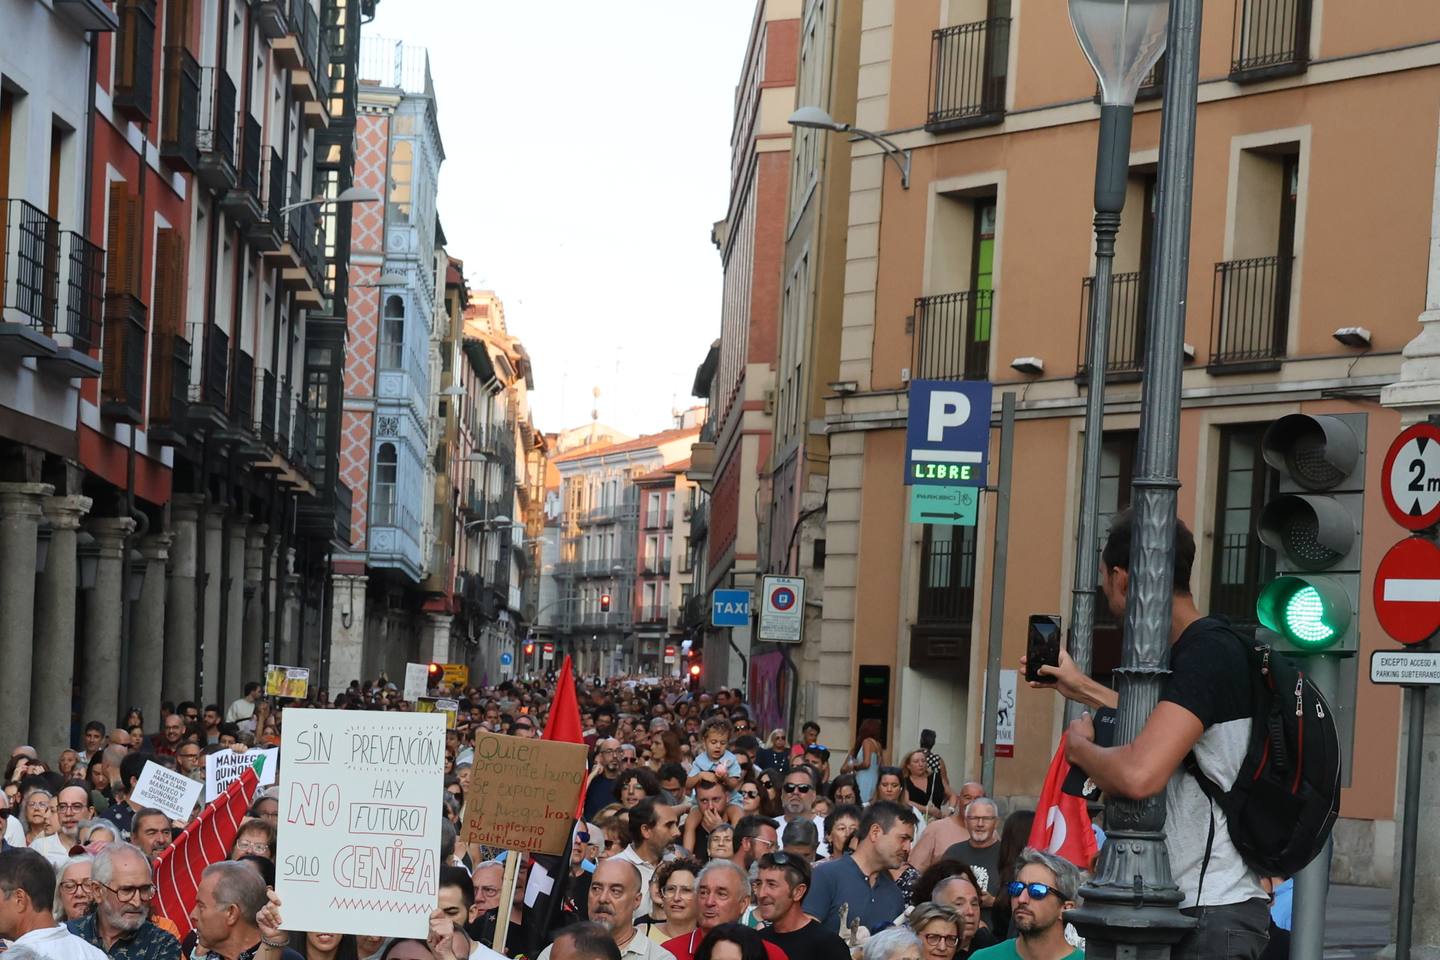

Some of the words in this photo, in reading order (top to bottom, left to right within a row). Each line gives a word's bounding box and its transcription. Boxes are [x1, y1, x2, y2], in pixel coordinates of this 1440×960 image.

[927, 391, 971, 442] P
[915, 464, 971, 479] LIBRE
[715, 602, 748, 615] TAXI
[1380, 658, 1409, 667] EXCEPTO
[1410, 659, 1432, 667] ACCESO
[1376, 670, 1400, 678] PARKING
[295, 724, 333, 762] SIN
[351, 731, 441, 766] PREVENCIÓN
[216, 754, 258, 768] MAÑUEC
[153, 774, 169, 784] HABLA
[169, 780, 186, 792] CLARO
[163, 771, 188, 787] ESTATUTO
[141, 790, 184, 813] RESPONSABLES
[287, 782, 341, 826] NO
[373, 779, 405, 799] HAY
[355, 806, 420, 832] FUTURO
[470, 815, 482, 831] al
[492, 820, 545, 838] infierno
[284, 855, 320, 877] SOLO
[333, 839, 436, 896] CENIZA
